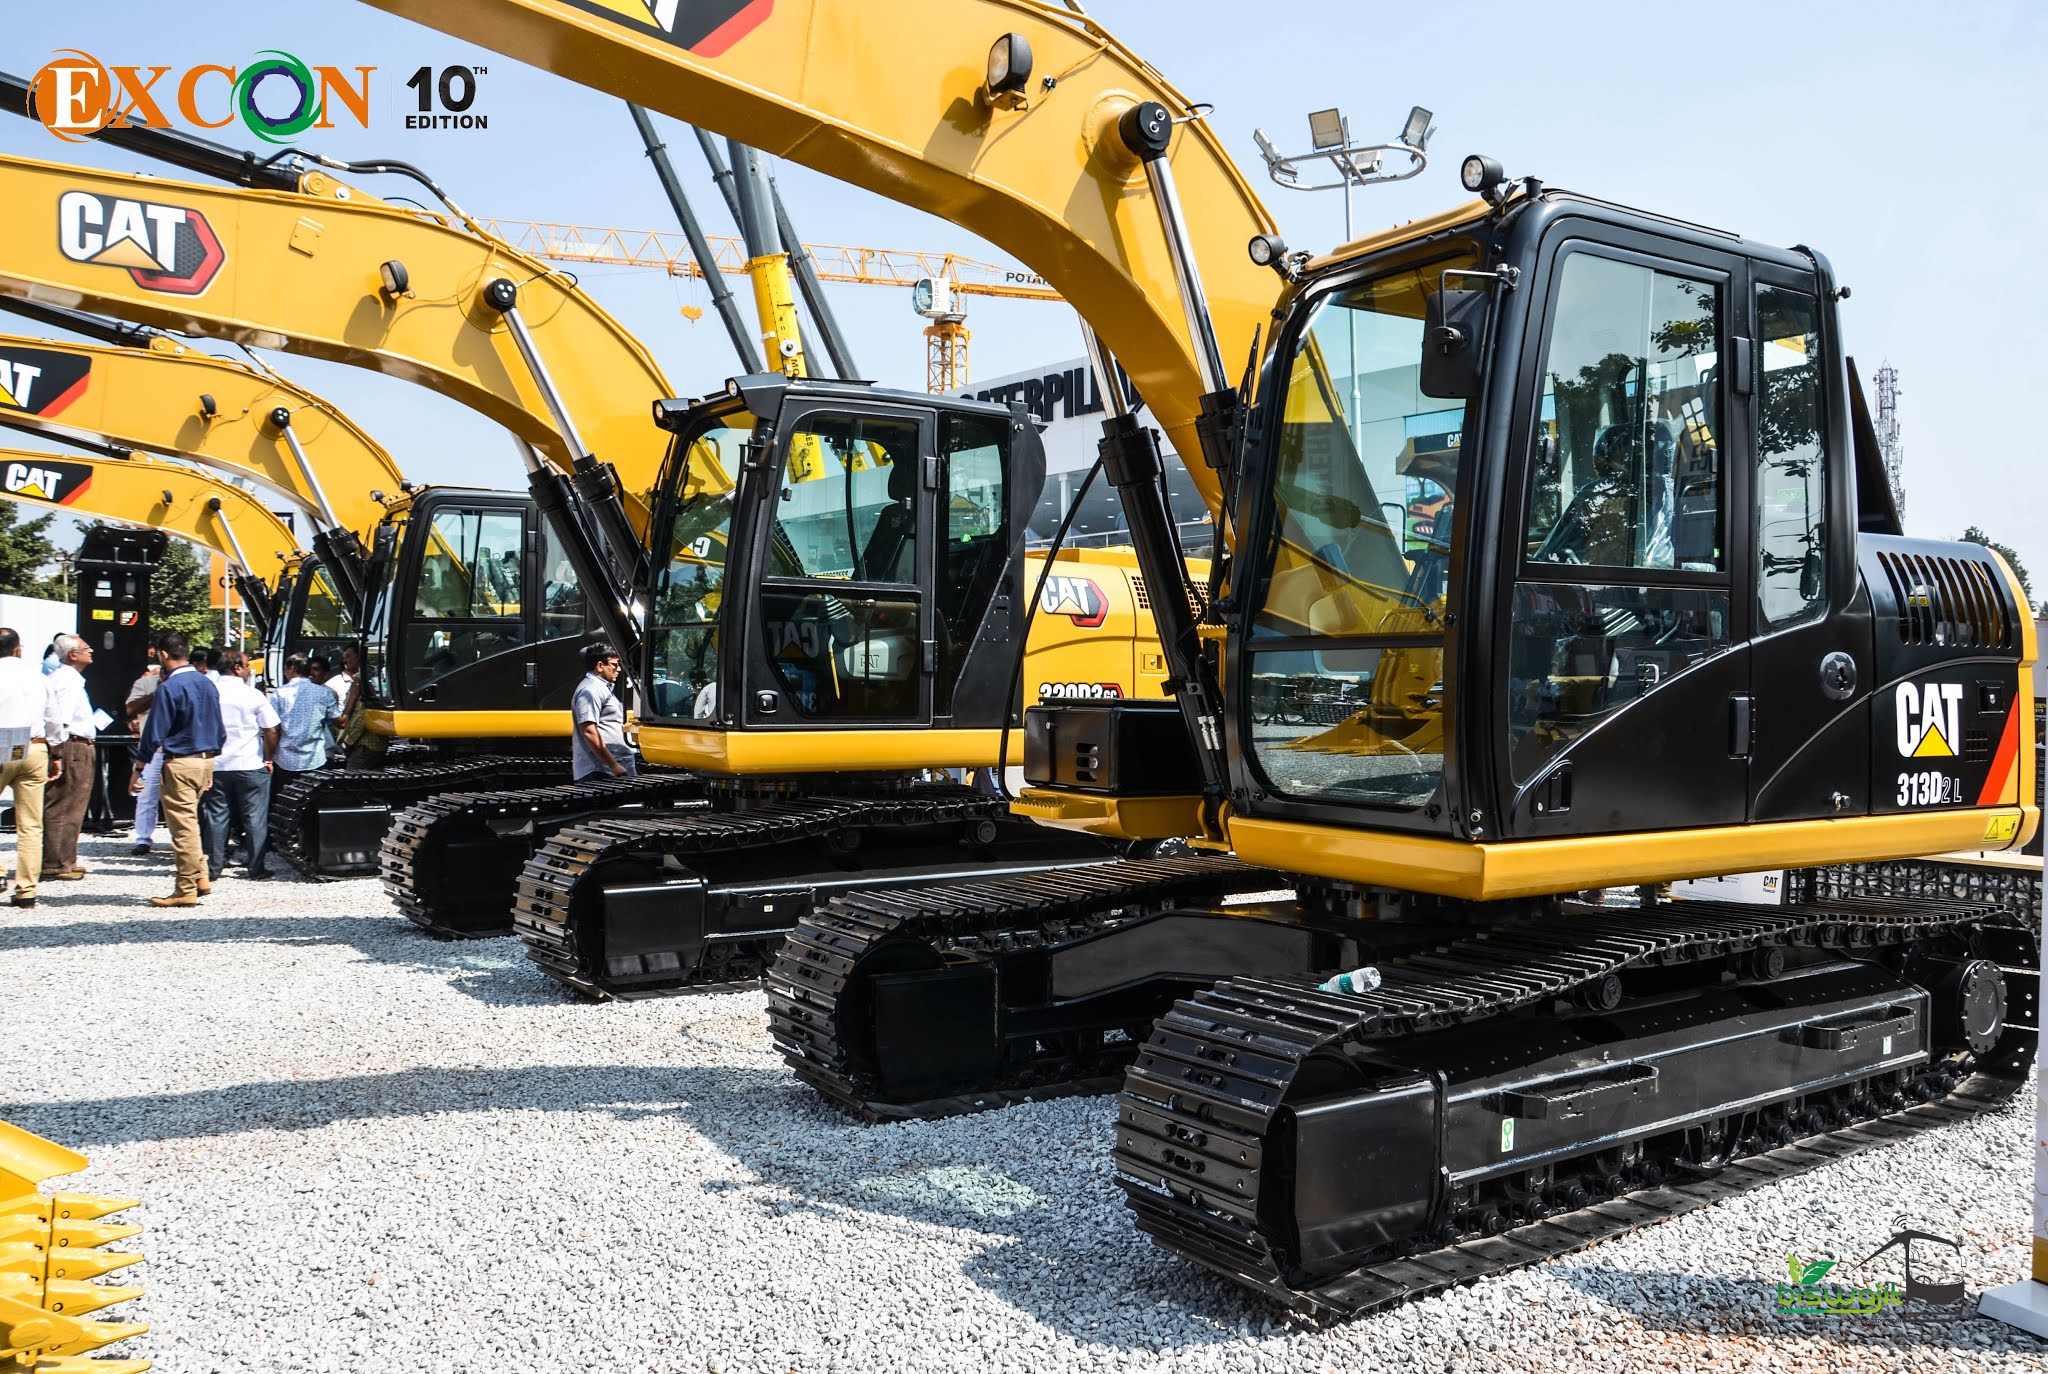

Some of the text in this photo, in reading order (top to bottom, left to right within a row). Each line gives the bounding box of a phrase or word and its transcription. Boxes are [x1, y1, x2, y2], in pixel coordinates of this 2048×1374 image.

[61, 192, 186, 272] CAT
[5, 463, 62, 500] CAT
[1037, 576, 1089, 615] CAT
[1896, 681, 1963, 758] CAT
[1954, 778, 1962, 803] L
[1763, 875, 1779, 888] CAT
